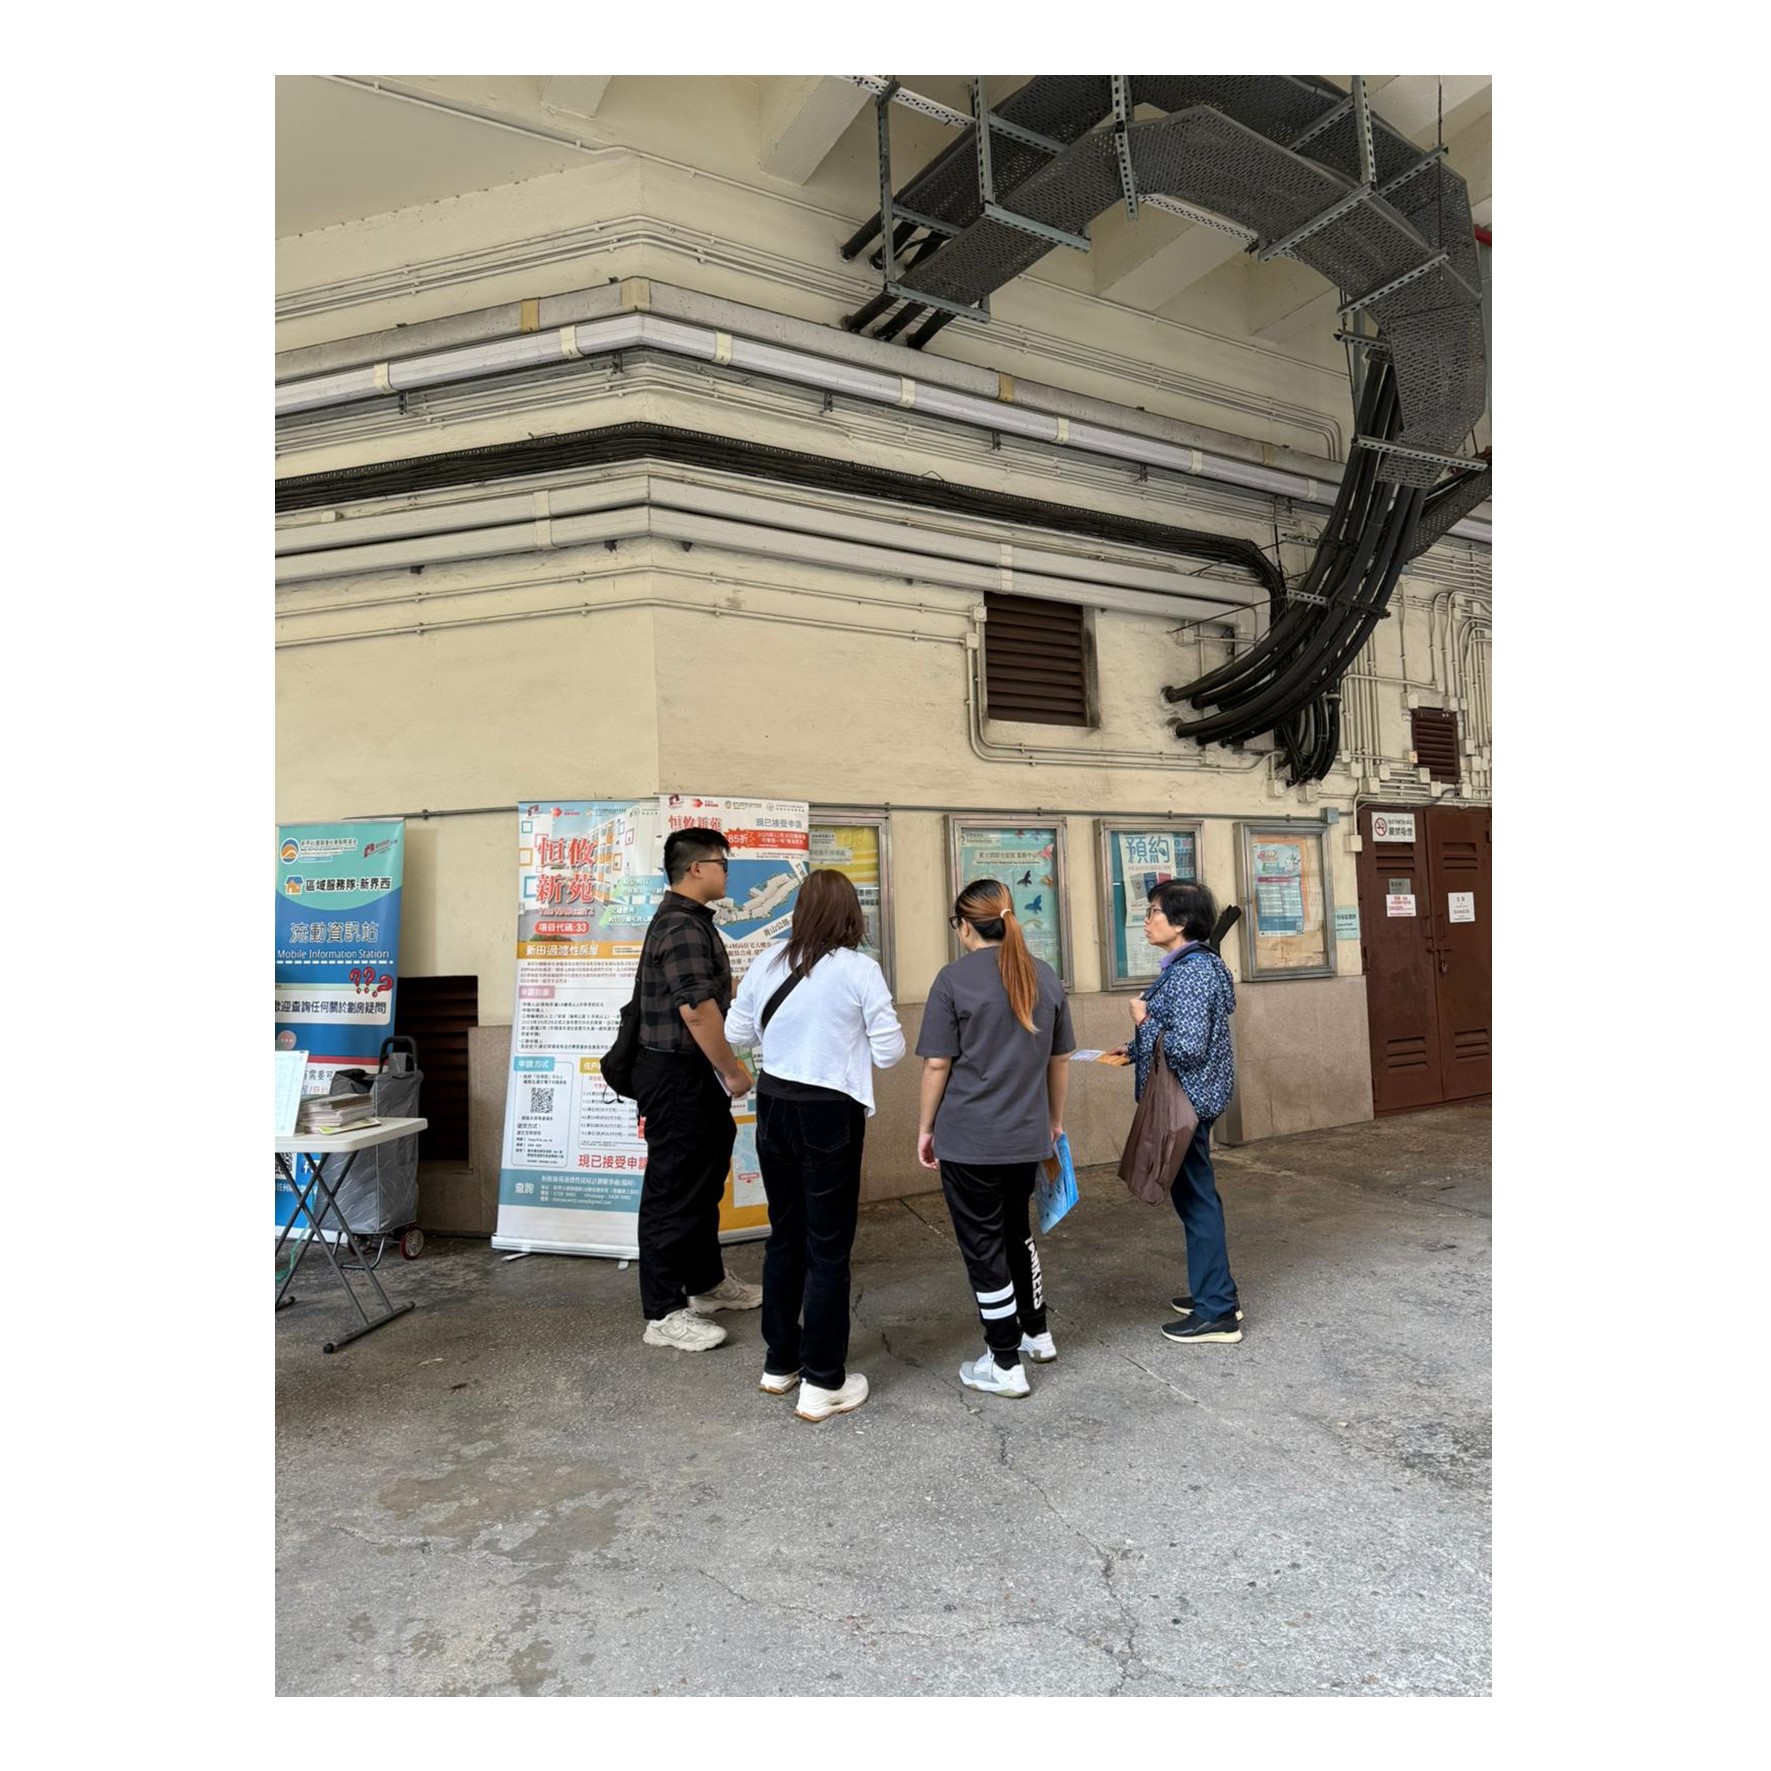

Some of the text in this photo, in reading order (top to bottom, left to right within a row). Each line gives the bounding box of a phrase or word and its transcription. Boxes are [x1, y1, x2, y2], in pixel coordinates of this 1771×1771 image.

[756, 817, 802, 829] 現已接受申請
[728, 833, 748, 845] 85折
[1125, 835, 1170, 864] 預約
[536, 872, 595, 903] 新苑
[289, 921, 379, 944] 流動資訊站
[277, 949, 390, 959] Mobile Information Station
[514, 1182, 534, 1194] 查詢
